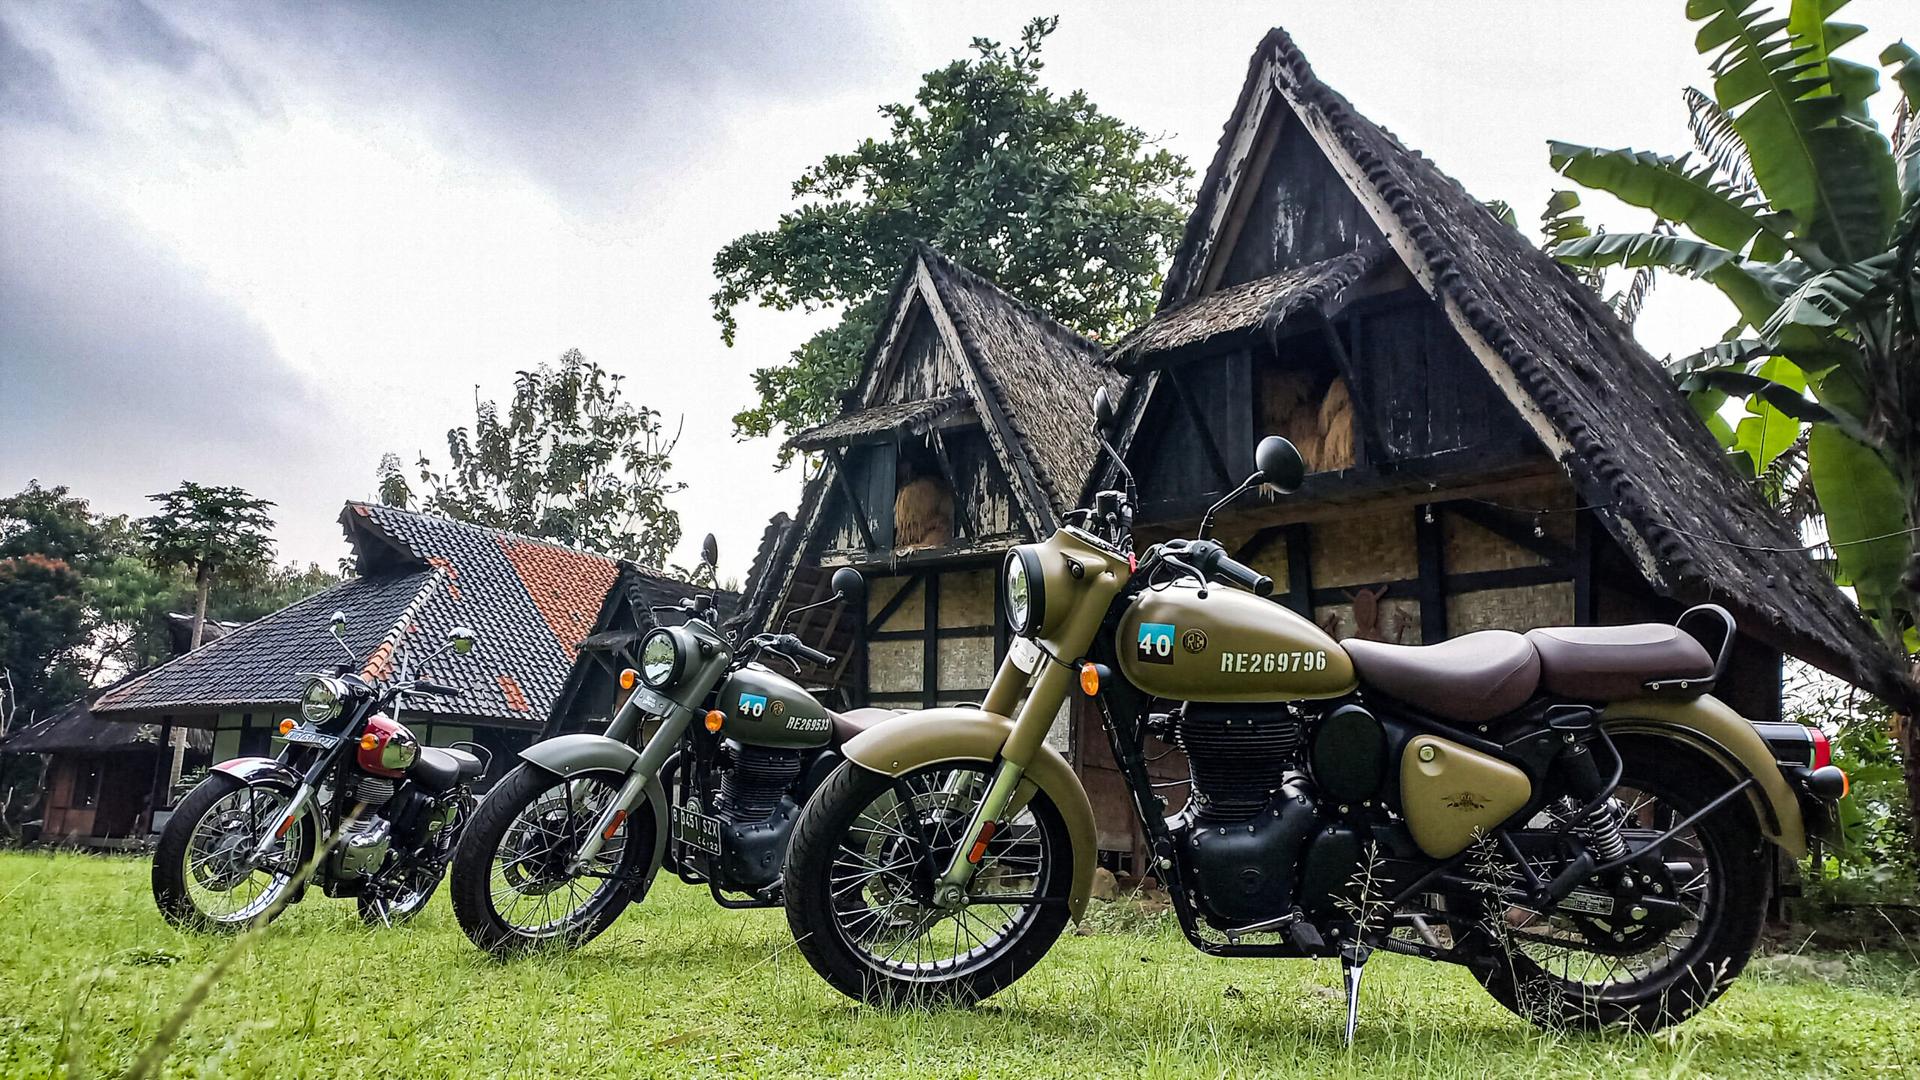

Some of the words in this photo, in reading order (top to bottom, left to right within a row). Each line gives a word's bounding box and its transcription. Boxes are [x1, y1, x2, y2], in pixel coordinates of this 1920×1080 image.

[1140, 633, 1171, 657] 40
[1187, 632, 1204, 651] RE
[1220, 650, 1327, 673] RE269796
[739, 700, 763, 717] 40
[786, 716, 830, 731] RE269533
[702, 819, 718, 838] SZX
